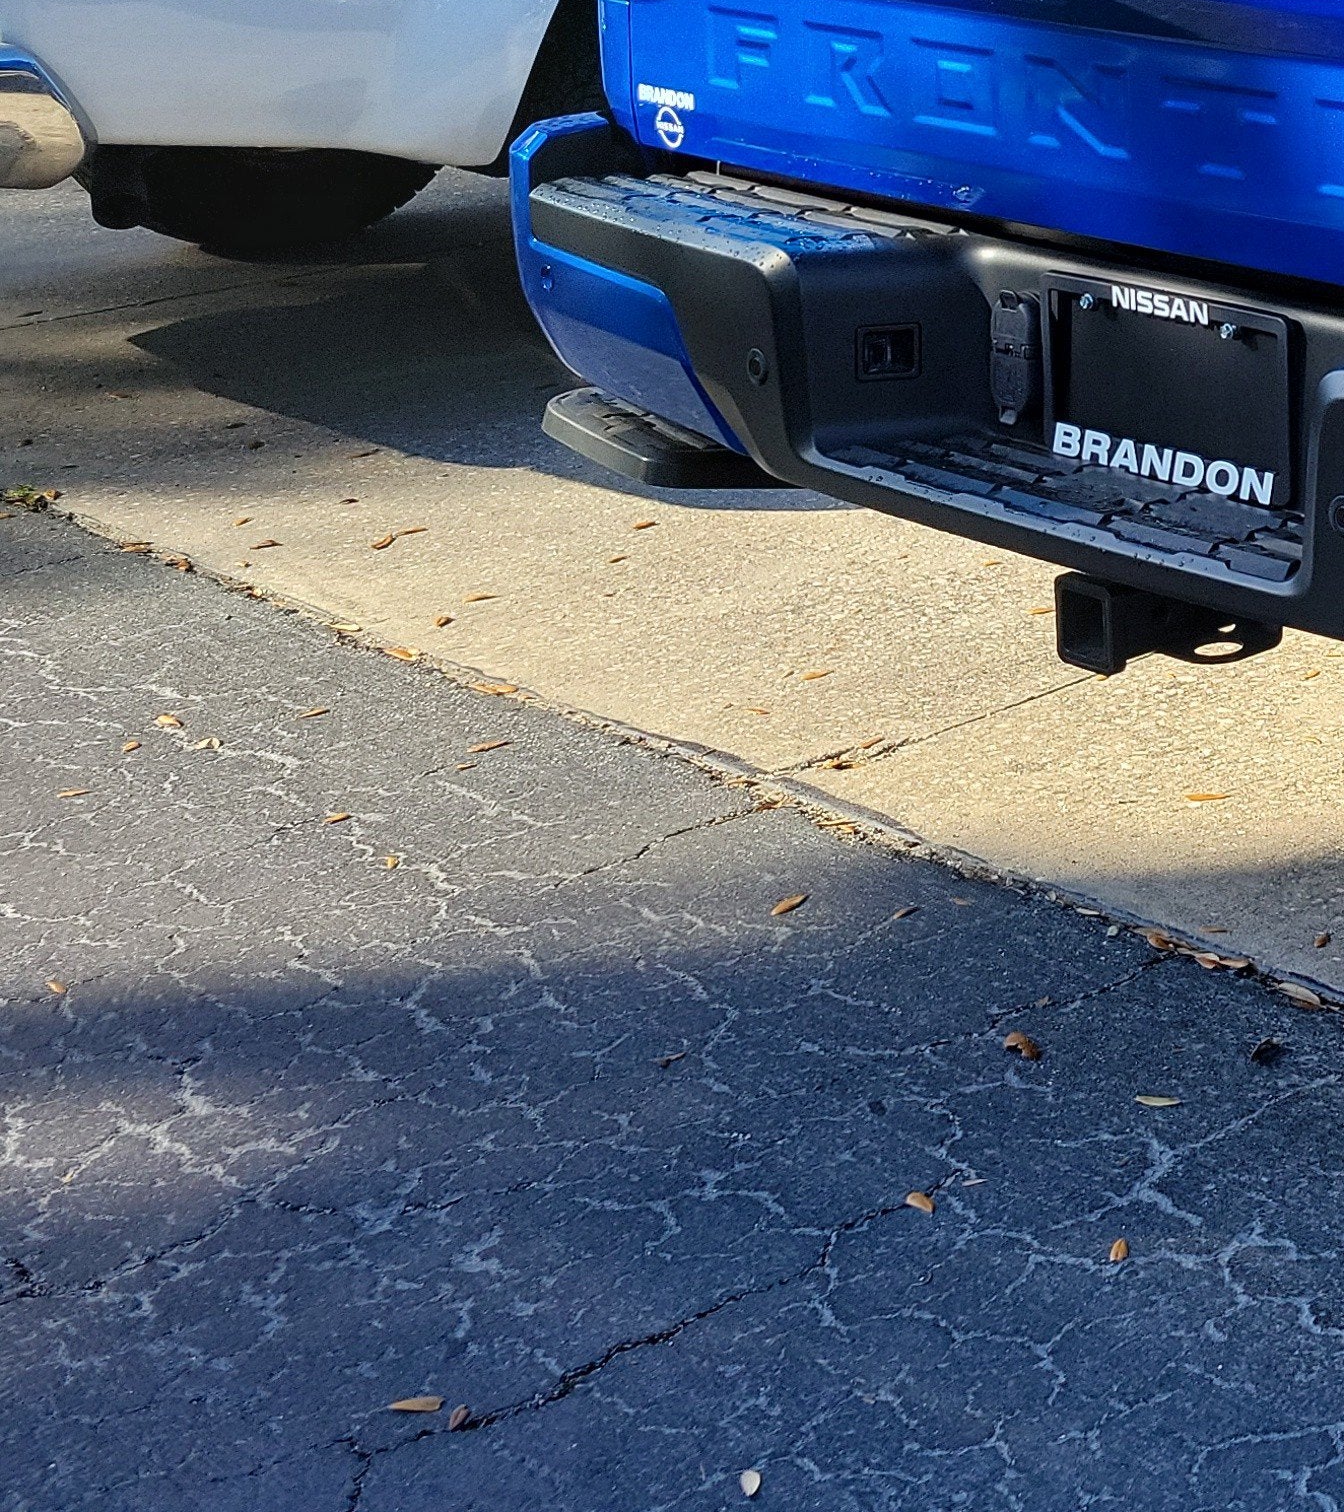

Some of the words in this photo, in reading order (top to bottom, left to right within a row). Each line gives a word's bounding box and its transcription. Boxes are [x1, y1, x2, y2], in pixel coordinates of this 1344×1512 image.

[638, 83, 695, 110] BRANDON
[1111, 285, 1209, 325] NISSAN
[1053, 422, 1274, 505] BRANDON
